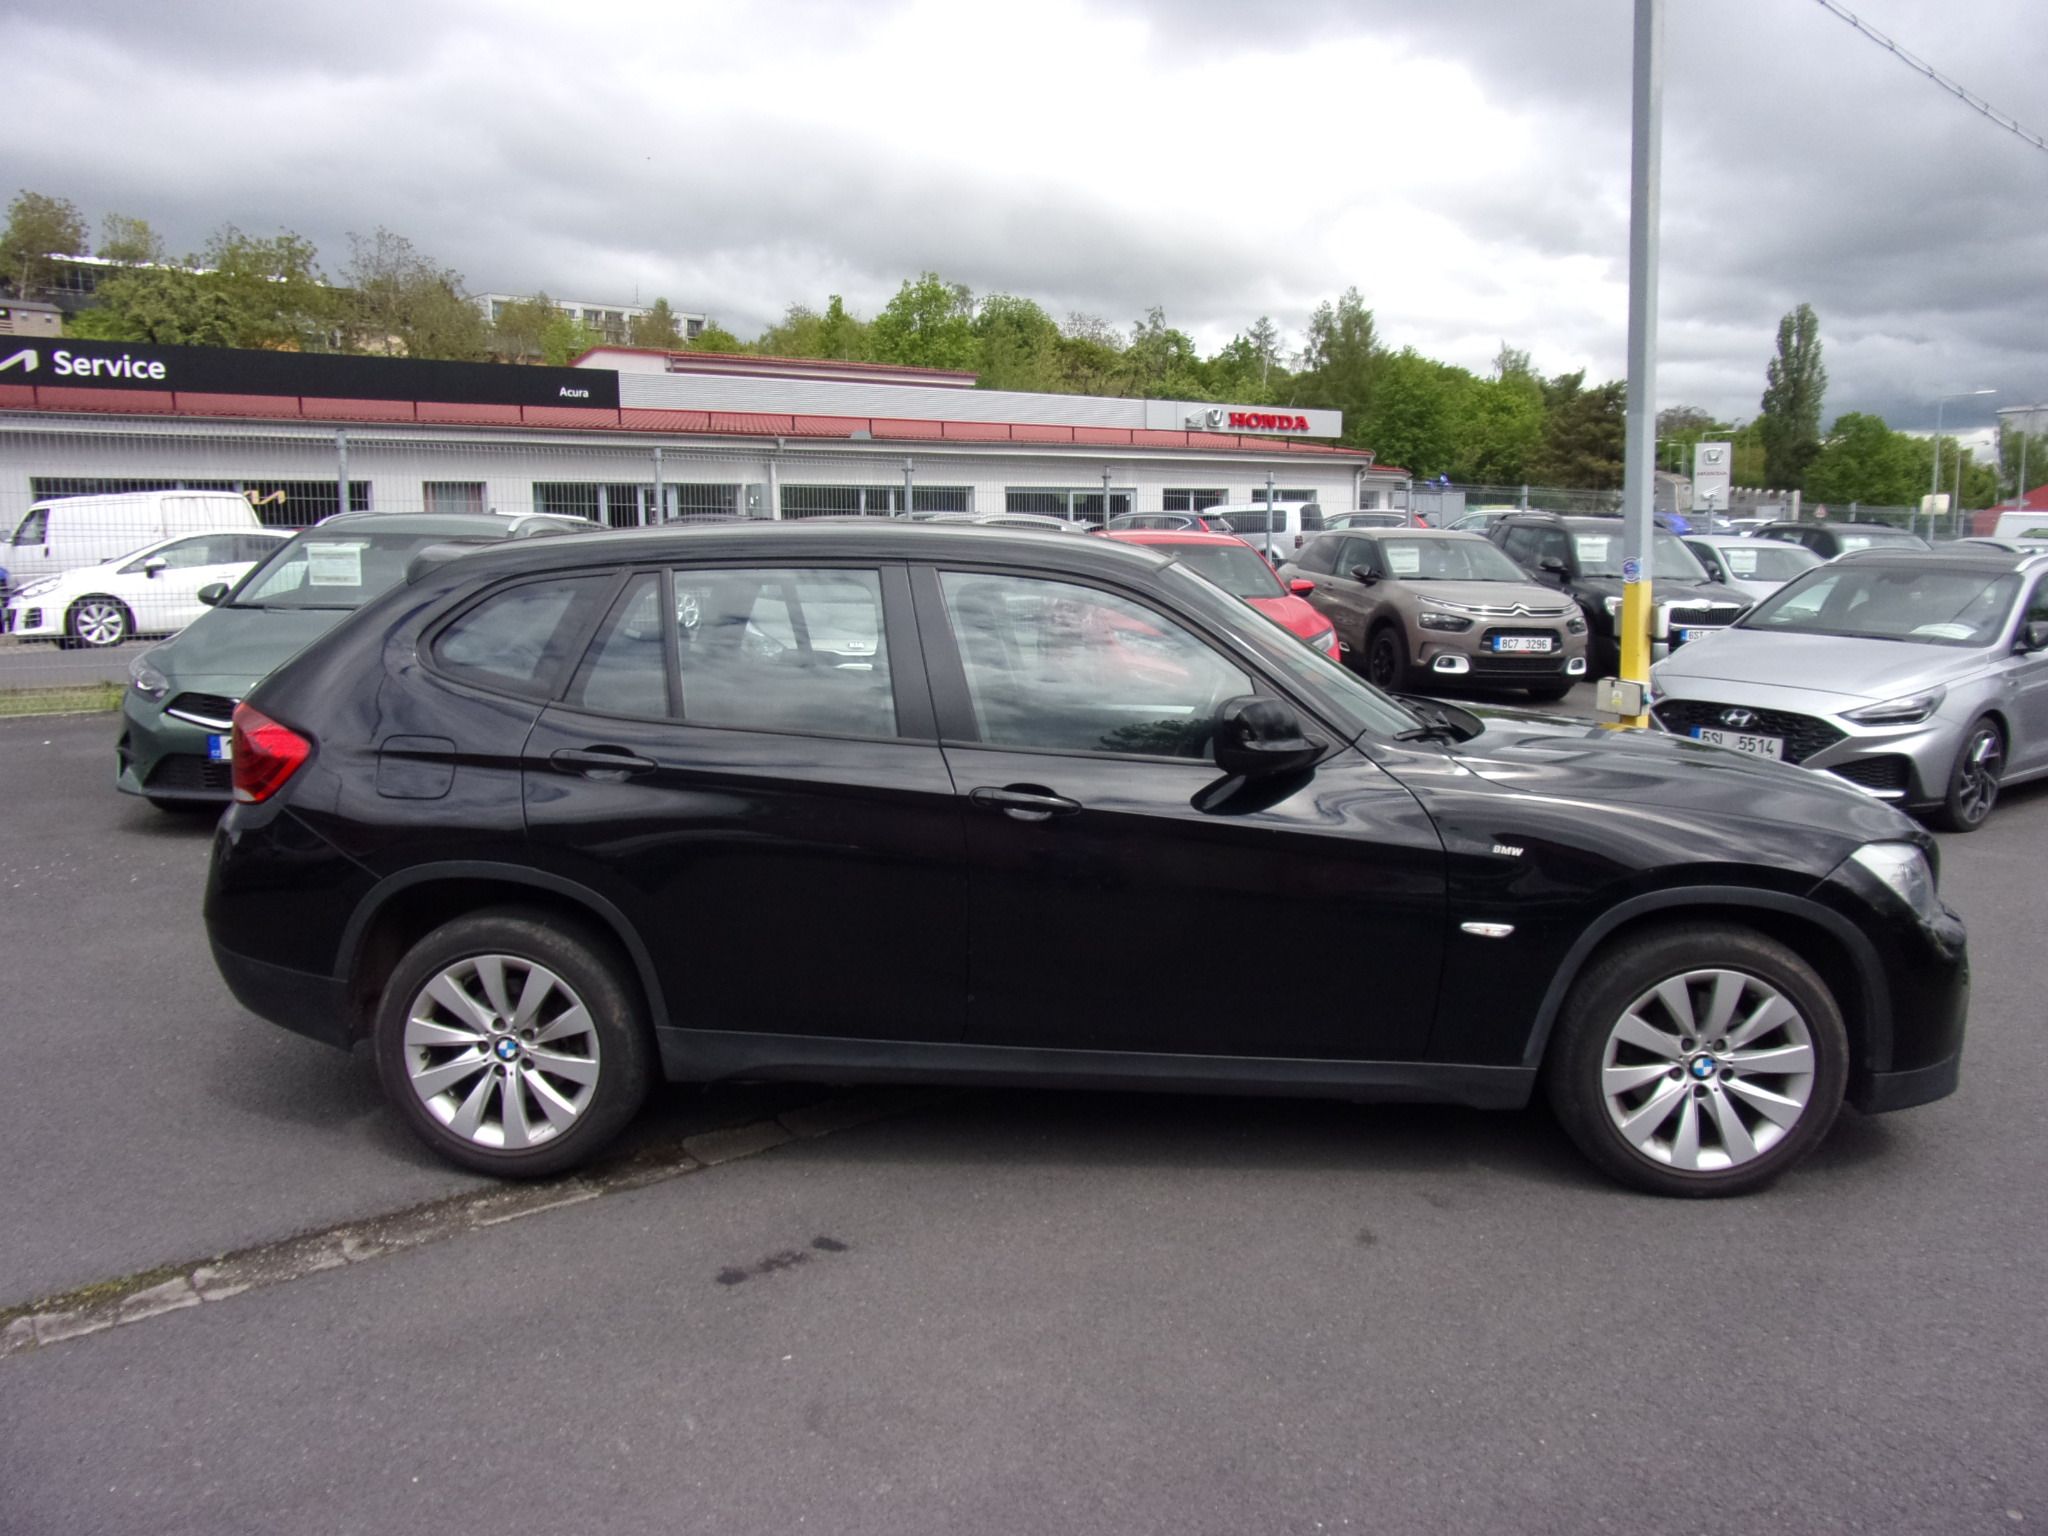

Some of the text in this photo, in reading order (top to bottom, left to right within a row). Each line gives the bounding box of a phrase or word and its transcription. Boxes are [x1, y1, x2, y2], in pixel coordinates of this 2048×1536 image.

[53, 350, 166, 380] Service
[559, 386, 589, 398] Acura
[1228, 412, 1310, 431] HONDA
[1502, 639, 1548, 649] 8C7 3296
[1738, 736, 1775, 754] 5514
[1492, 844, 1524, 857] BMW
